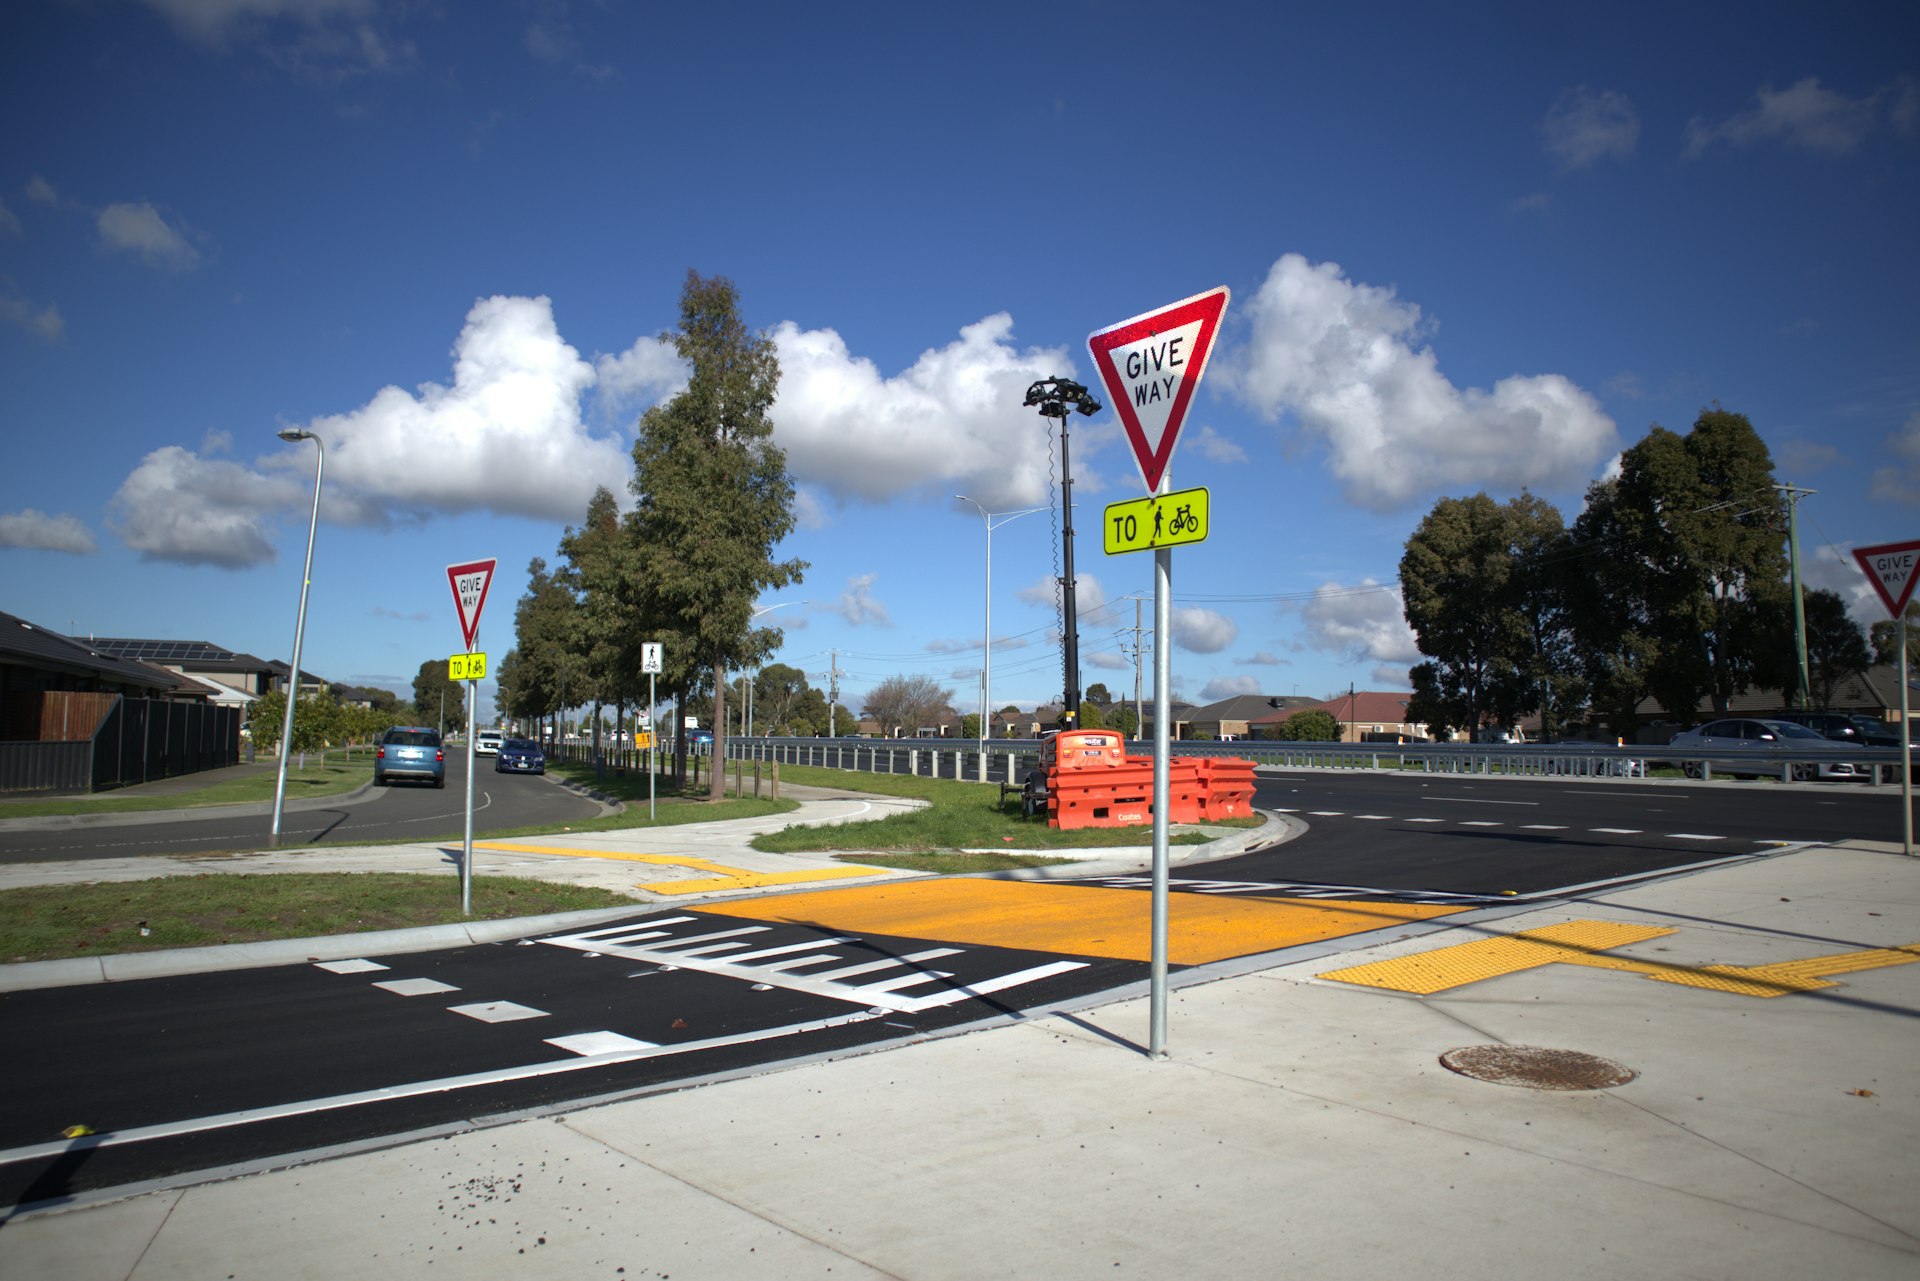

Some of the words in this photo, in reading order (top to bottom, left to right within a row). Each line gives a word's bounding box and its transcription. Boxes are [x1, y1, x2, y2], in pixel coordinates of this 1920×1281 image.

[1127, 336, 1183, 379] GIVE
[1135, 375, 1174, 407] WAY
[1113, 514, 1136, 543] TO
[1877, 555, 1912, 570] GIVE
[1883, 571, 1907, 583] WAY
[460, 577, 481, 593] GIVE
[462, 595, 478, 608] WAY
[452, 661, 462, 675] TO
[1118, 813, 1142, 821] Coates
